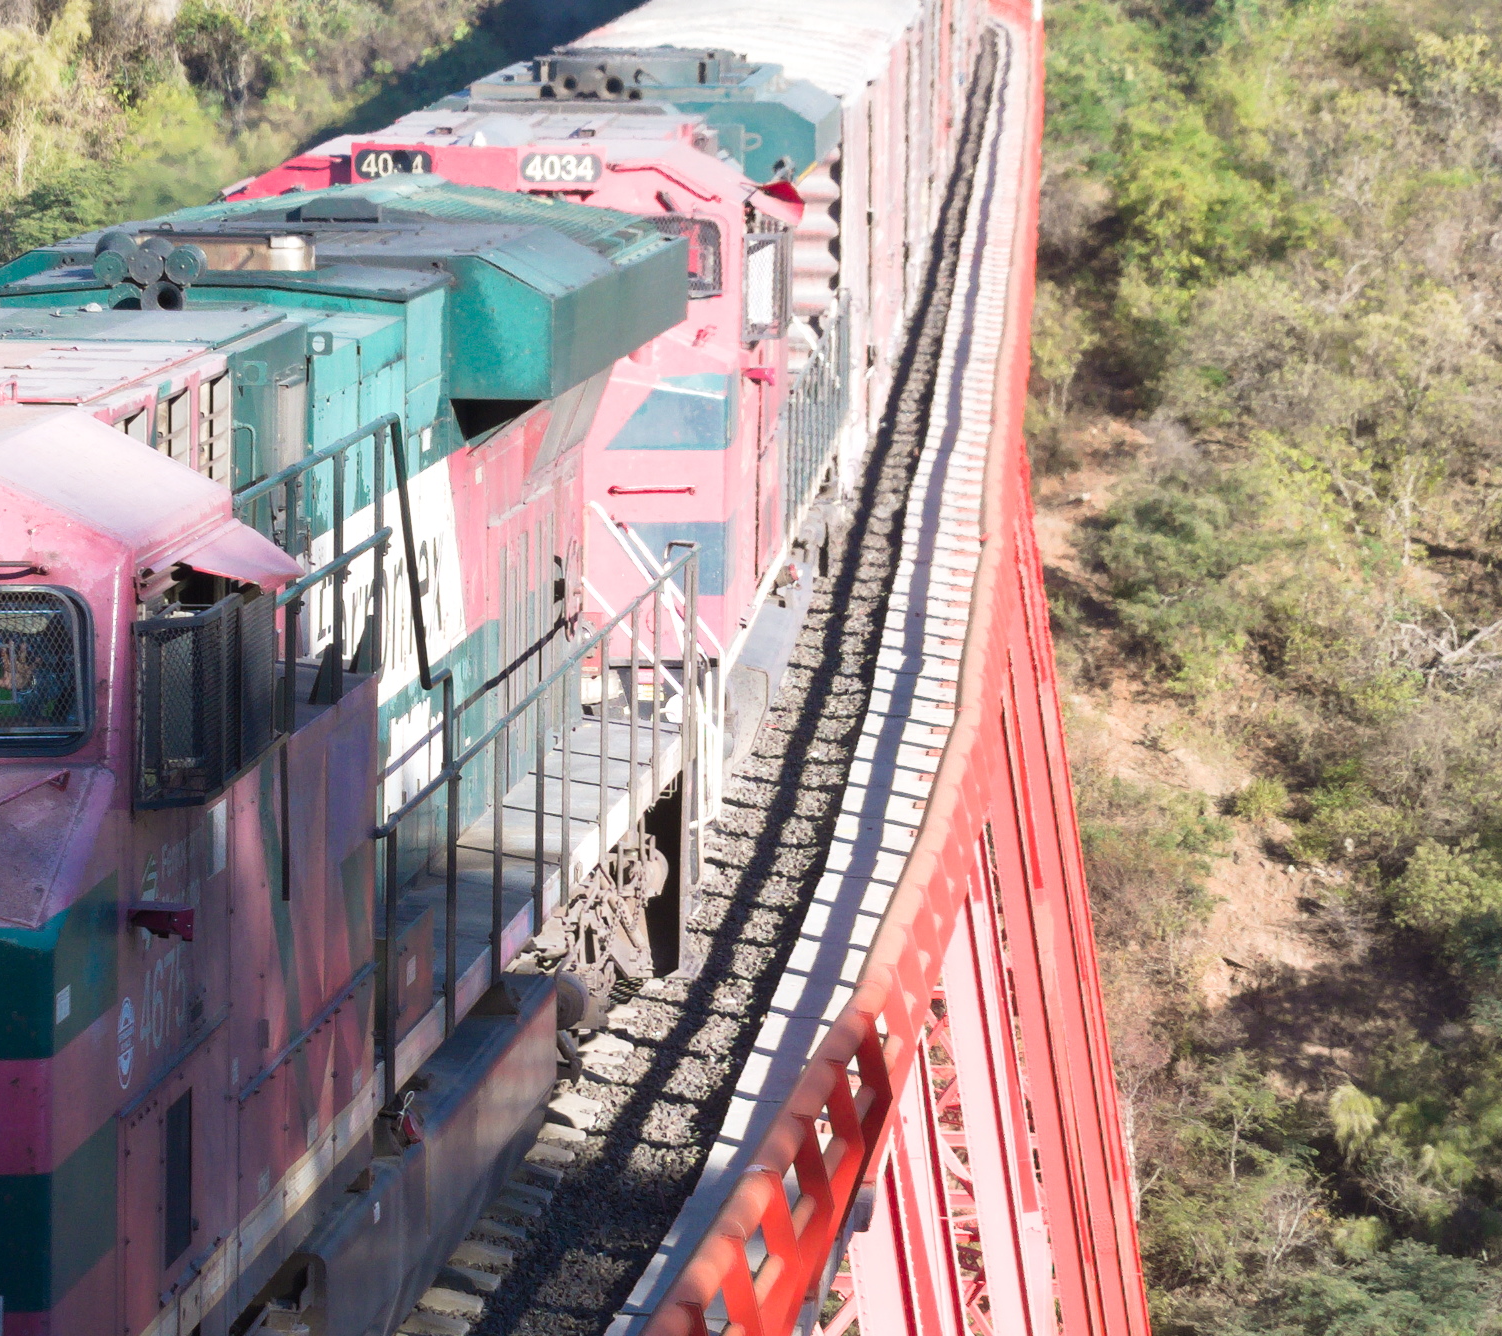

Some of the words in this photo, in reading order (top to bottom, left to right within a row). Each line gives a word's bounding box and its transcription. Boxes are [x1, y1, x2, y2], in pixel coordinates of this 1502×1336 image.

[360, 152, 423, 177] 404
[525, 154, 594, 182] 4034
[139, 942, 187, 1057] 4675
